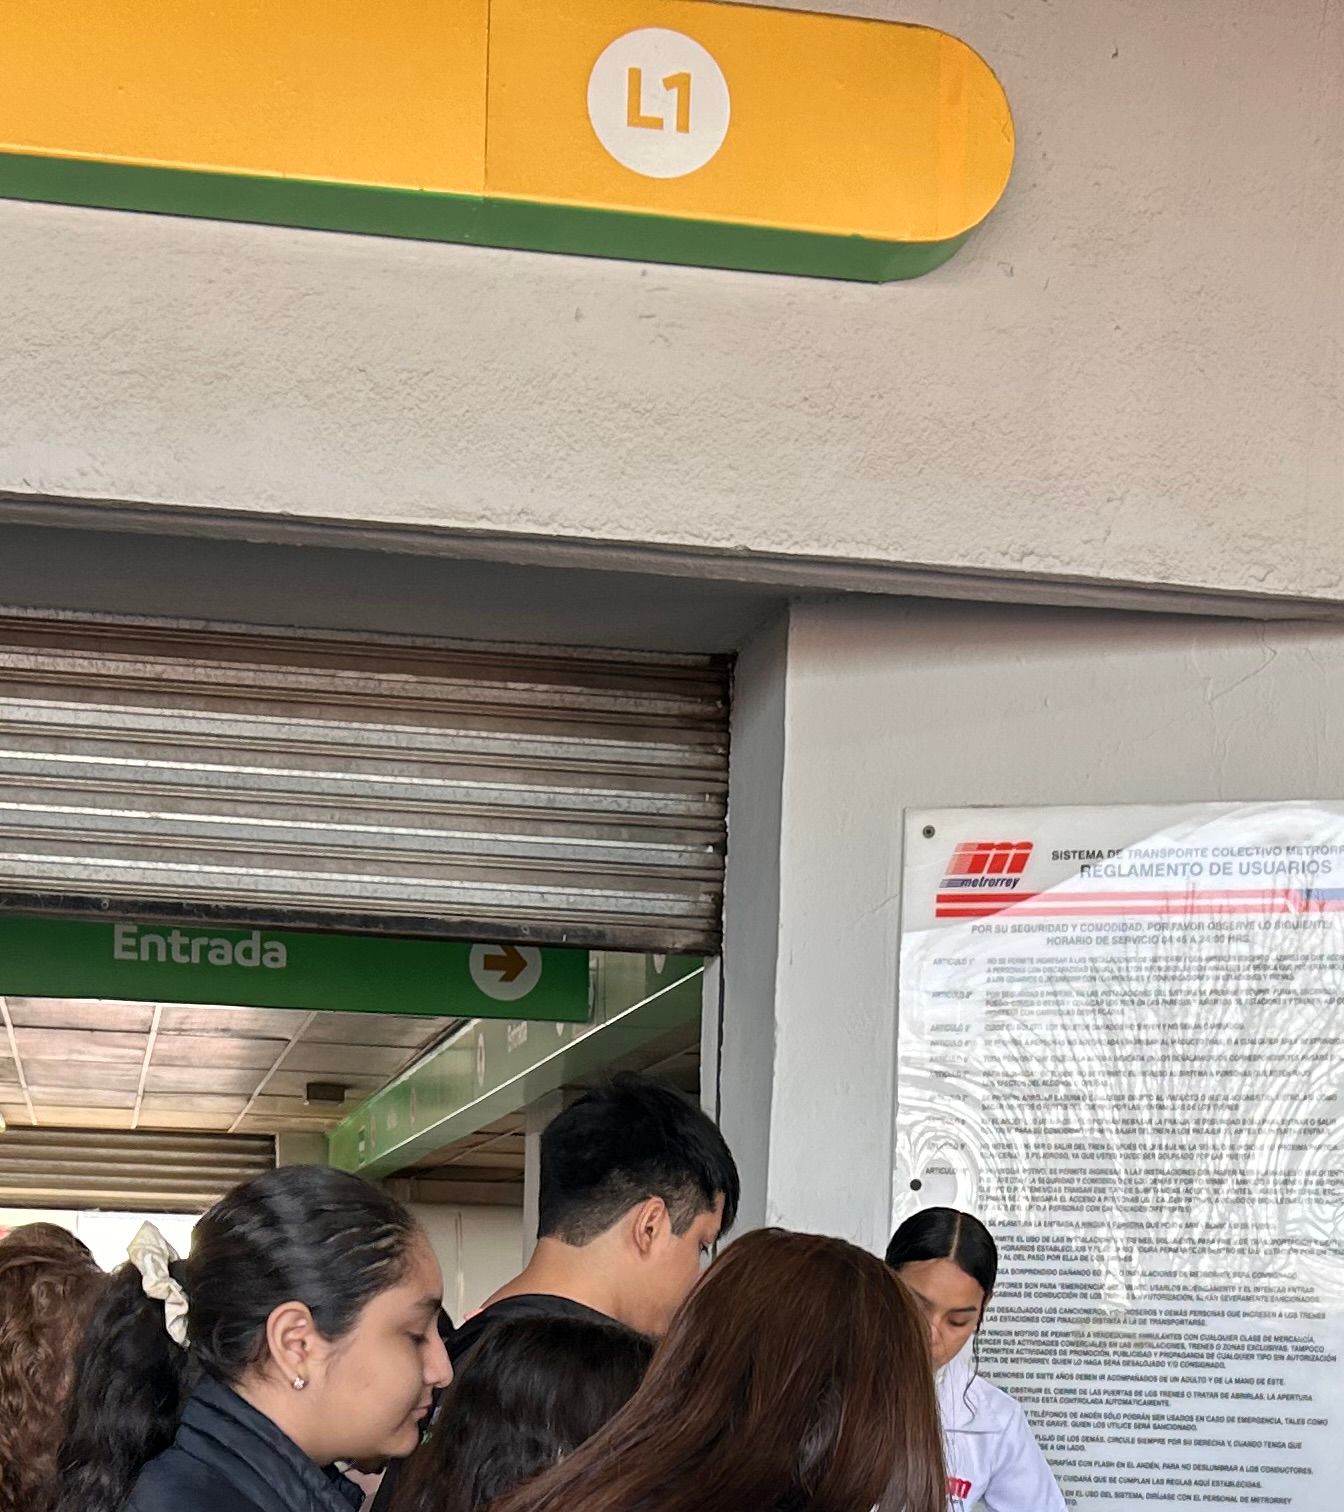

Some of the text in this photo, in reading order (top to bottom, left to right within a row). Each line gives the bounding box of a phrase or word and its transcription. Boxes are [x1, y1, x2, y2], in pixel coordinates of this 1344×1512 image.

[626, 66, 691, 134] L1
[1051, 848, 1105, 860] SISTEMA
[1106, 848, 1123, 859] DE
[1128, 846, 1208, 859] TRANSPORTE
[1211, 845, 1282, 858] COLECTIVO
[1080, 860, 1332, 878] REGLAMENTO DE USUARIOS
[959, 876, 1020, 890] metrorrey
[971, 923, 992, 933] POR
[994, 923, 1008, 933] SU
[1010, 922, 1069, 933] SEGURIDAD
[1146, 921, 1170, 932] POR
[1206, 920, 1255, 931] OBSERVE
[113, 923, 287, 969] Entrada
[1065, 1489, 1292, 1505] EN EL USO DEL SISTEMA, DIRÍJASE CON EL PERSONAL DE METRORREY
